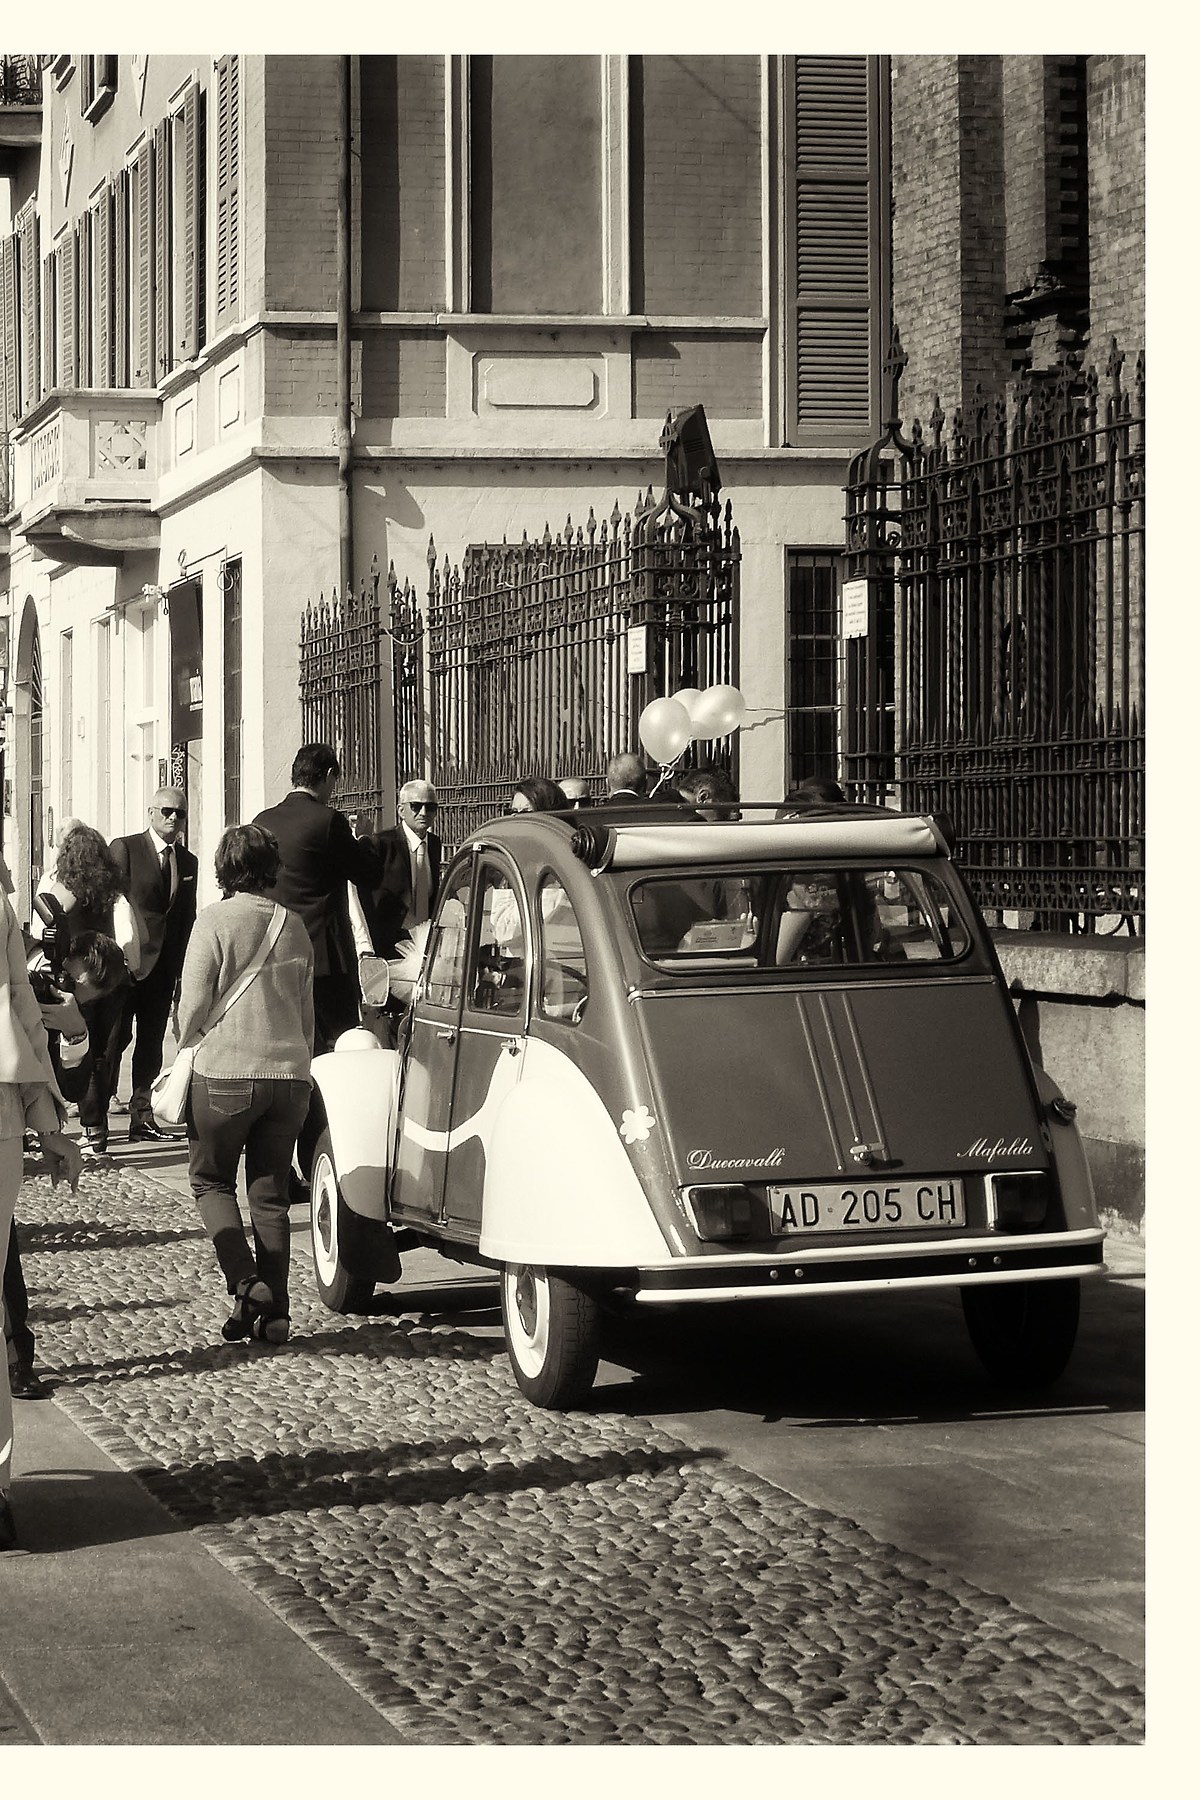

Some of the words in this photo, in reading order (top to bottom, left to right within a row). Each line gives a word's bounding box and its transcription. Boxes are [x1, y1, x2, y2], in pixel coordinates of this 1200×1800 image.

[686, 1147, 786, 1170] Duecavalli
[956, 1136, 1034, 1163] Mafalda
[781, 1192, 820, 1228] AD
[841, 1187, 902, 1225] 205
[916, 1183, 957, 1221] CH
